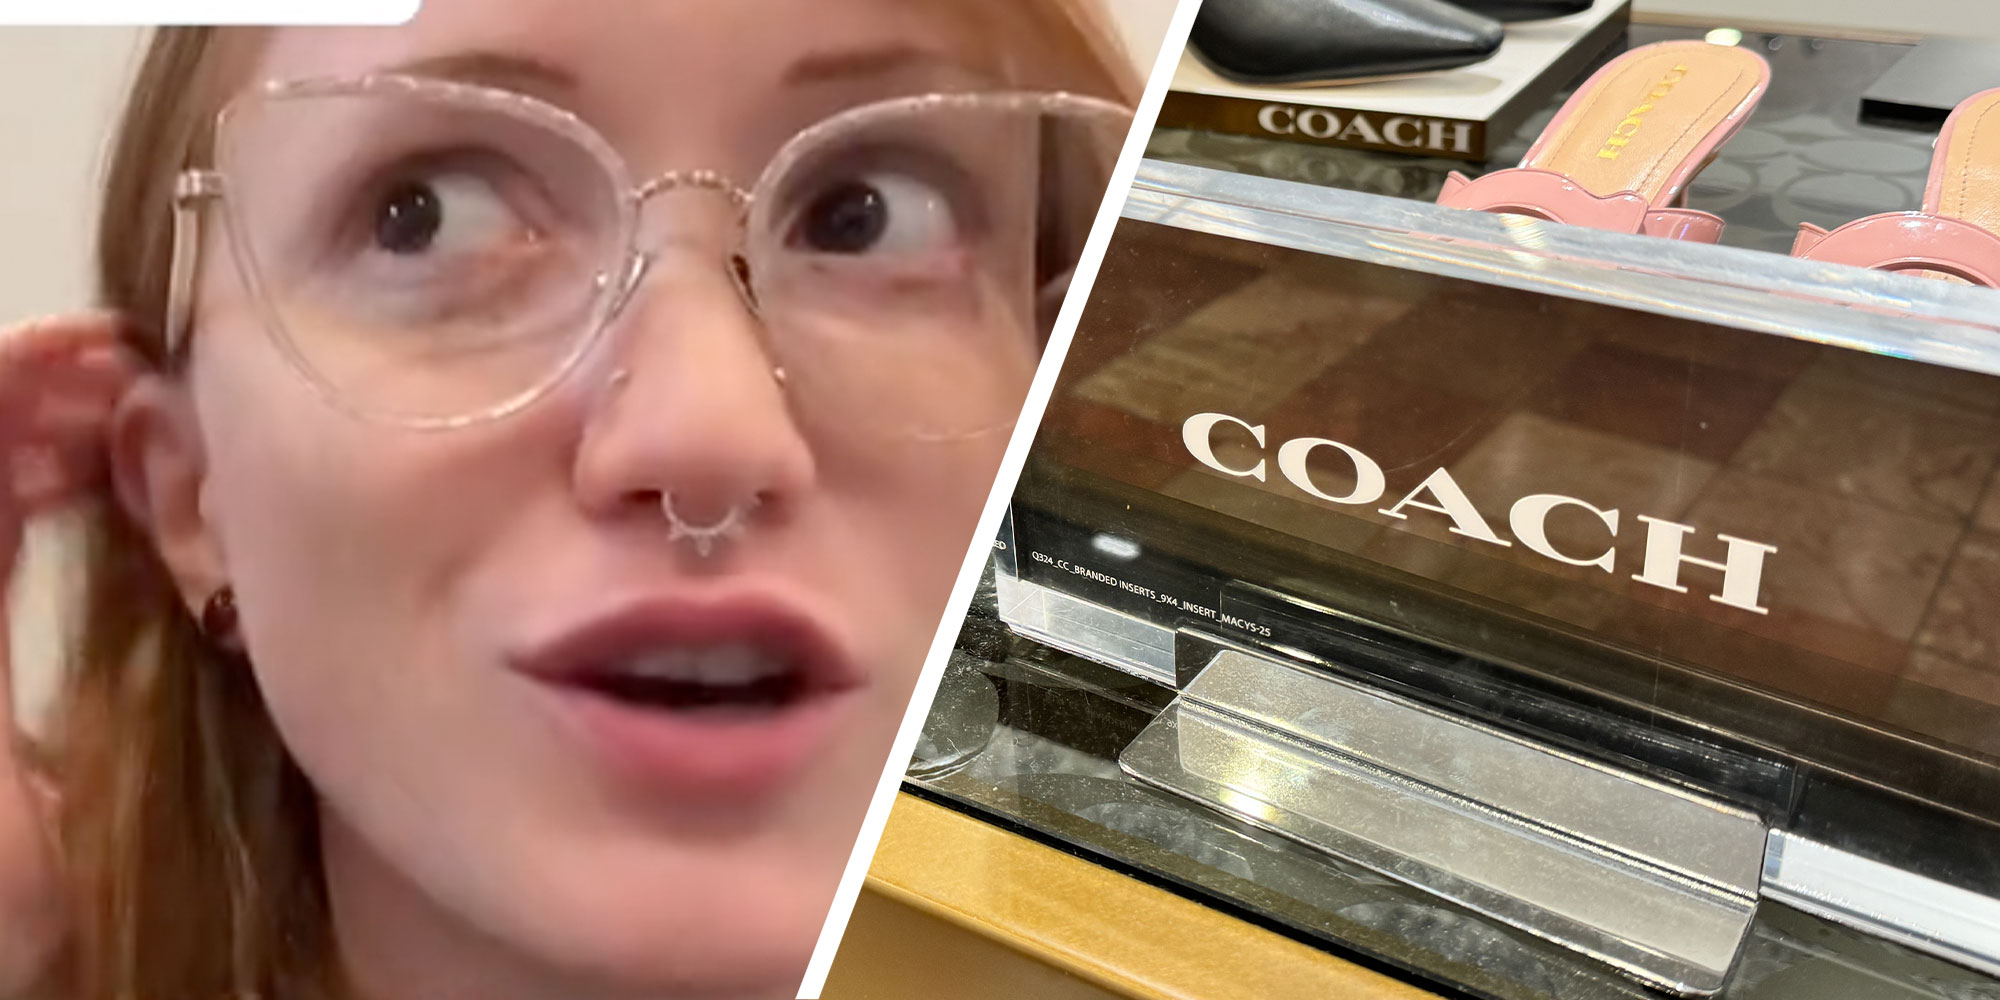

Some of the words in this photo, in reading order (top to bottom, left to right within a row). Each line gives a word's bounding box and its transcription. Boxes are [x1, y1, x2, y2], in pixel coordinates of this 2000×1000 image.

[1258, 103, 1474, 154] COACH
[1596, 65, 1689, 160] COACH
[1182, 412, 1778, 615] COACH
[1031, 550, 1118, 587] Q324_CC_BRANDED
[1119, 579, 1272, 637] INSERTS_9X4_INSERT_MACYS-25
